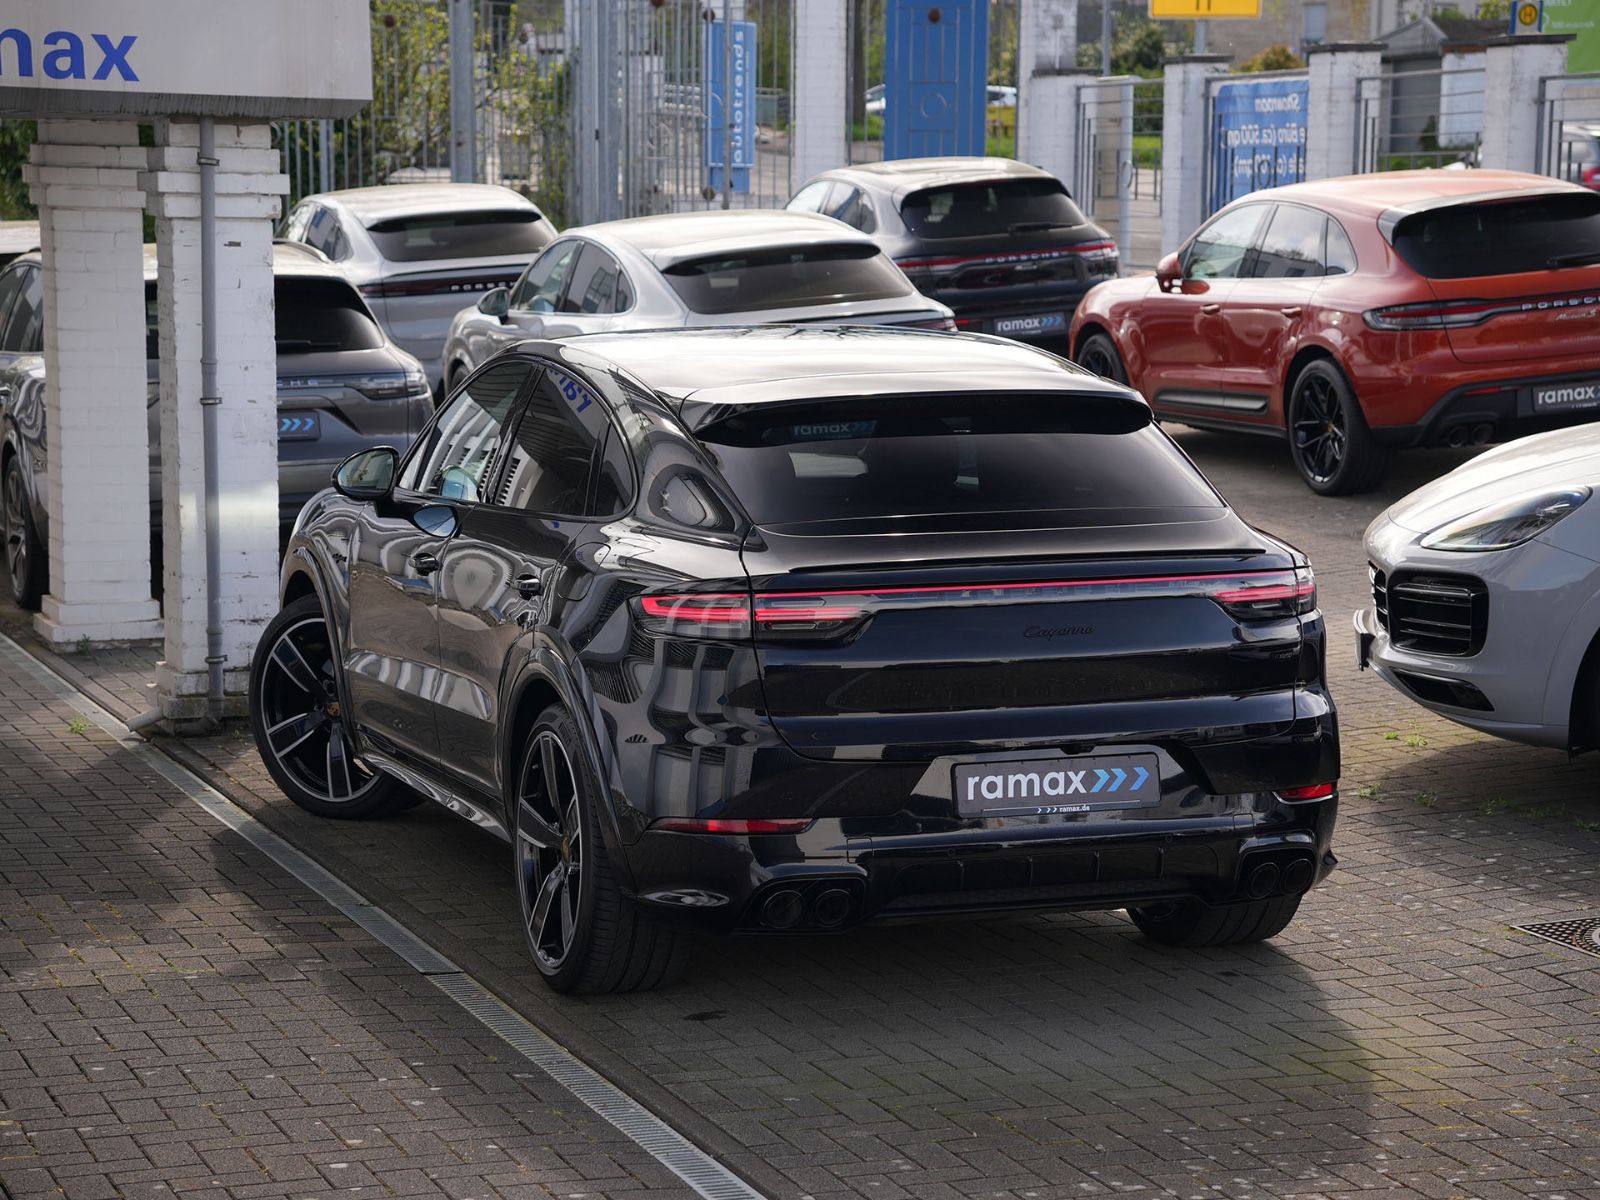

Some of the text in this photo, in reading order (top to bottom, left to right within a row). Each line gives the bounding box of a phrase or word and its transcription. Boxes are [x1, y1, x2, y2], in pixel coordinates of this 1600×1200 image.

[732, 30, 744, 163] autotrends
[985, 251, 1059, 264] PORSCHE
[451, 281, 516, 292] PORSC
[1521, 296, 1600, 310] PORSC
[997, 317, 1041, 332] ramax
[1538, 386, 1595, 404] ramax
[1024, 626, 1095, 641] Cayenne
[967, 769, 1087, 800] ramax
[1059, 804, 1090, 813] ramax.de
